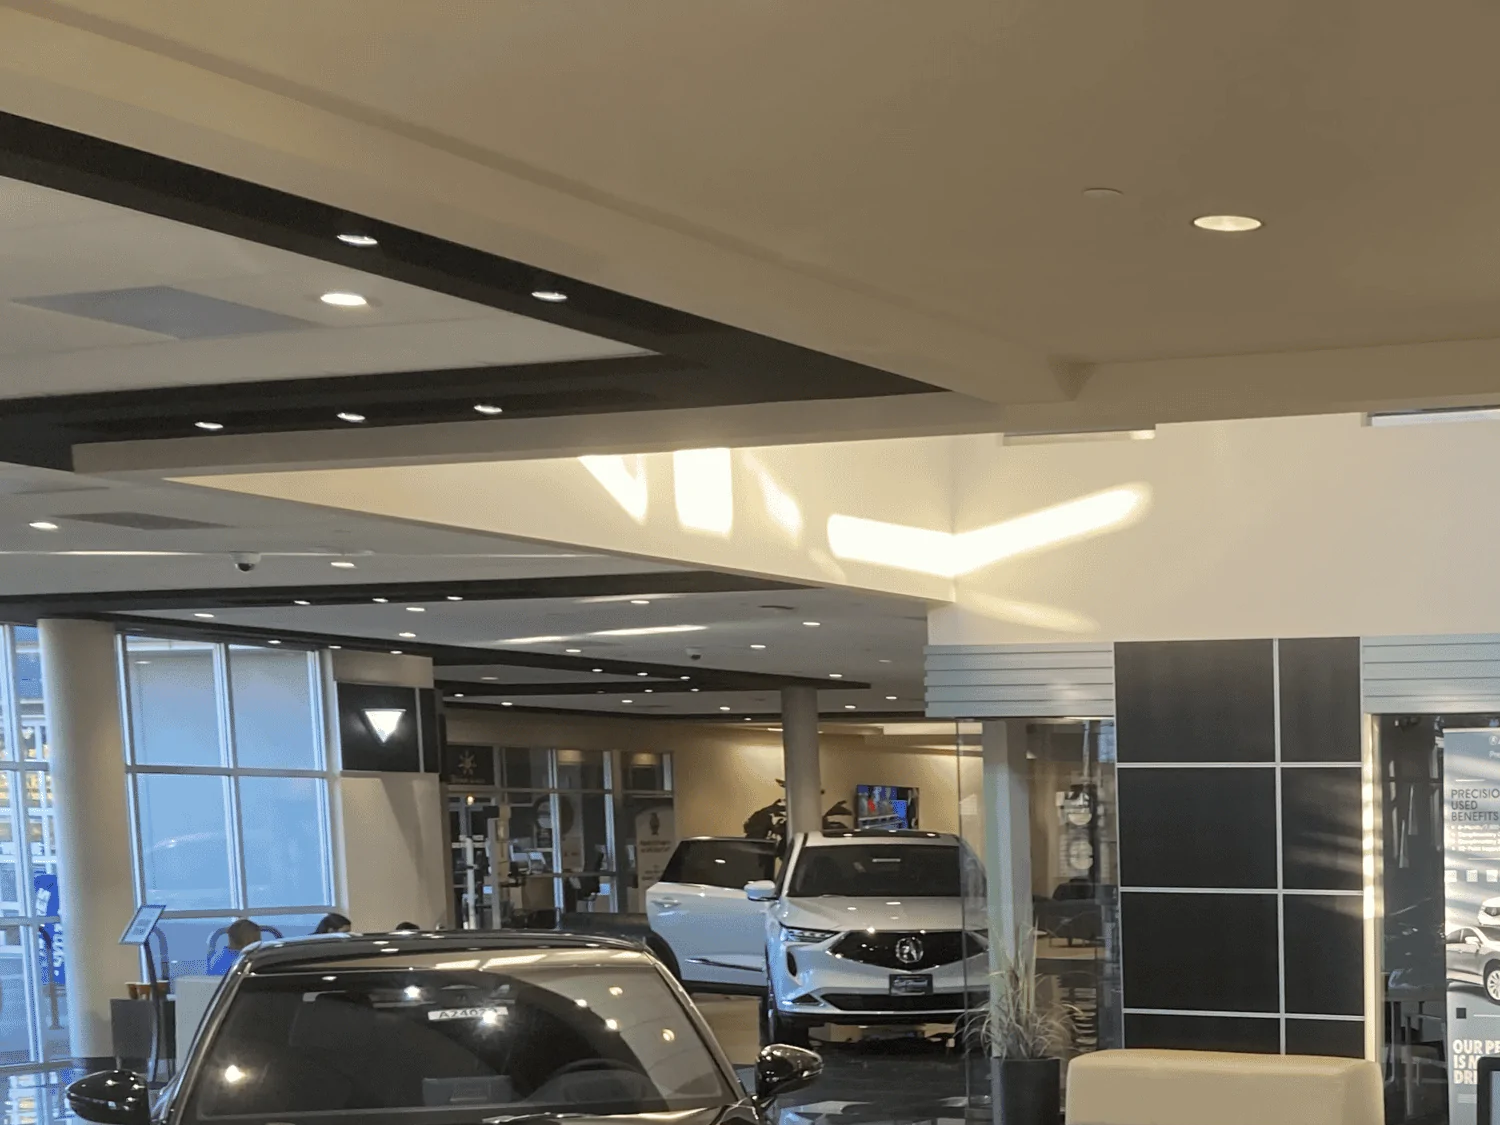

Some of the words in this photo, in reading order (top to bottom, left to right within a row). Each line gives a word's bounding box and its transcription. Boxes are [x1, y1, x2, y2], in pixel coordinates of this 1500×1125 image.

[1451, 800, 1478, 810] USED
[1451, 811, 1499, 821] BENEFITS
[440, 1007, 498, 1019] A2402
[1453, 1039, 1482, 1054] OUR
[1454, 1055, 1466, 1069] IS
[1454, 1070, 1478, 1084] DRI
